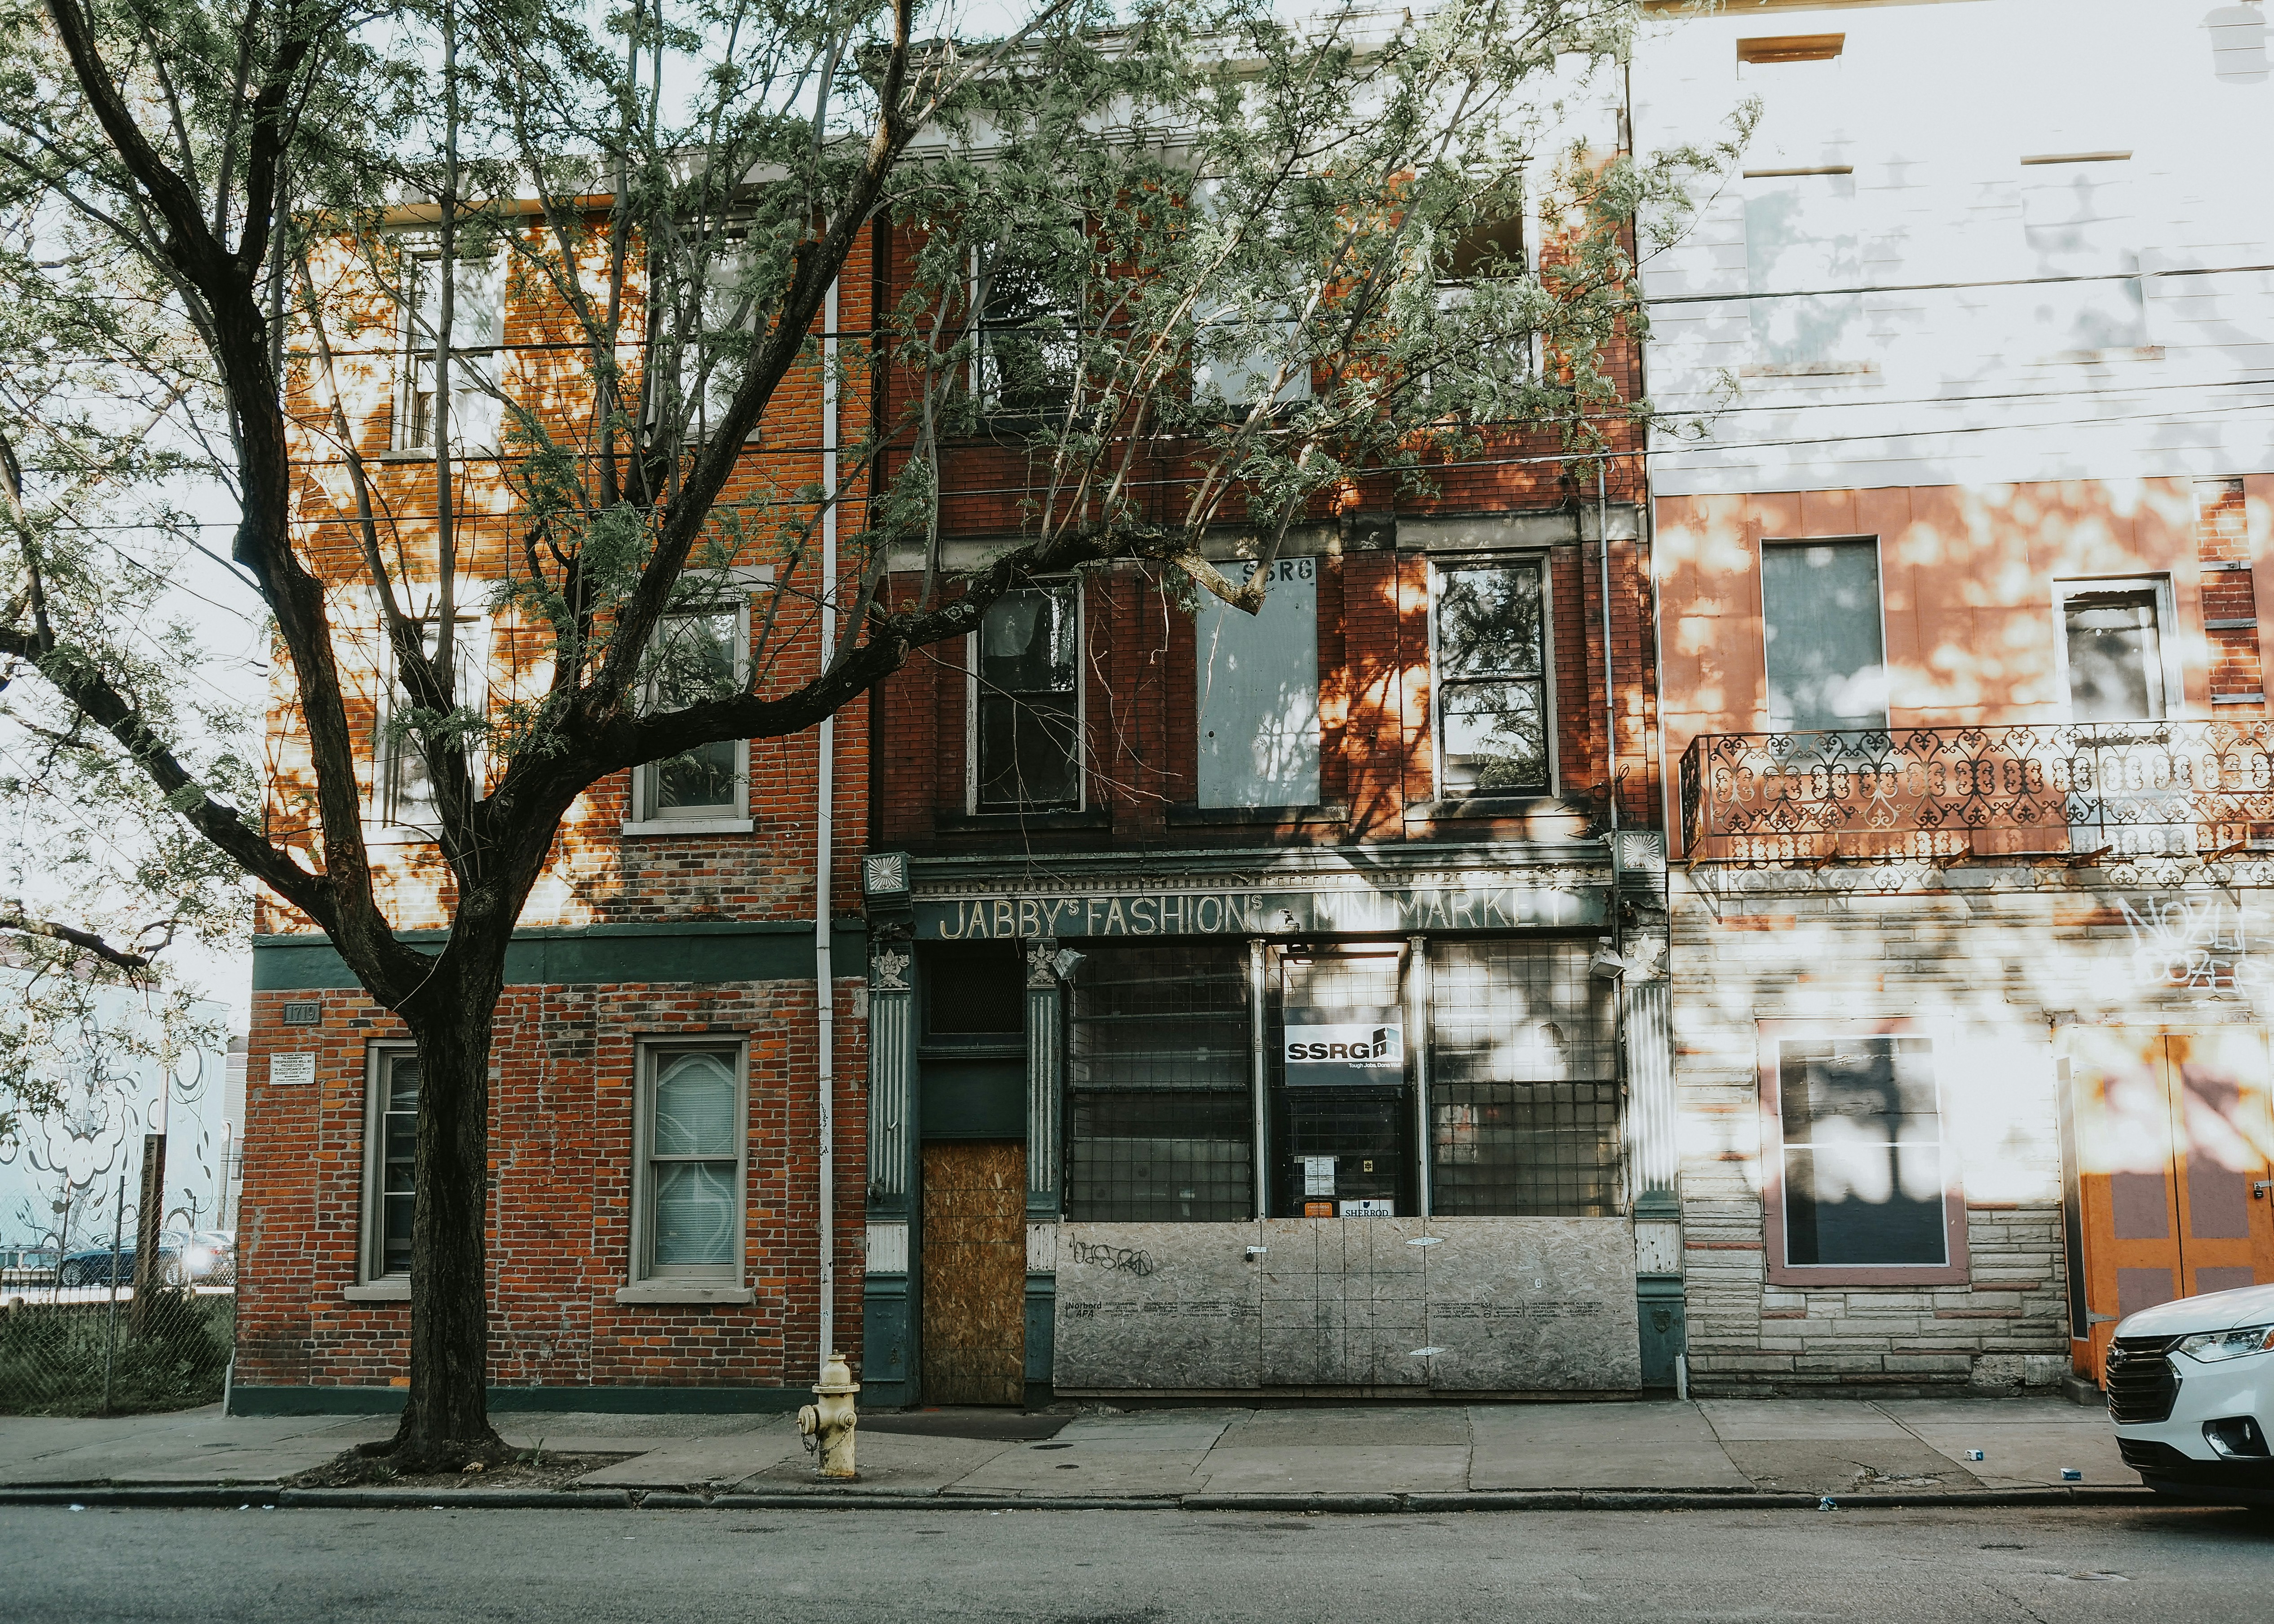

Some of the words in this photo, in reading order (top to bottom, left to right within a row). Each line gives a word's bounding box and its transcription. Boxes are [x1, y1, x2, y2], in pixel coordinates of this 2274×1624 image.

[1393, 887, 1571, 929] MARKET
[1288, 1043, 1370, 1059] SSRG
[1068, 1301, 1102, 1309] Norbord
[1076, 1309, 1094, 1318] APA
